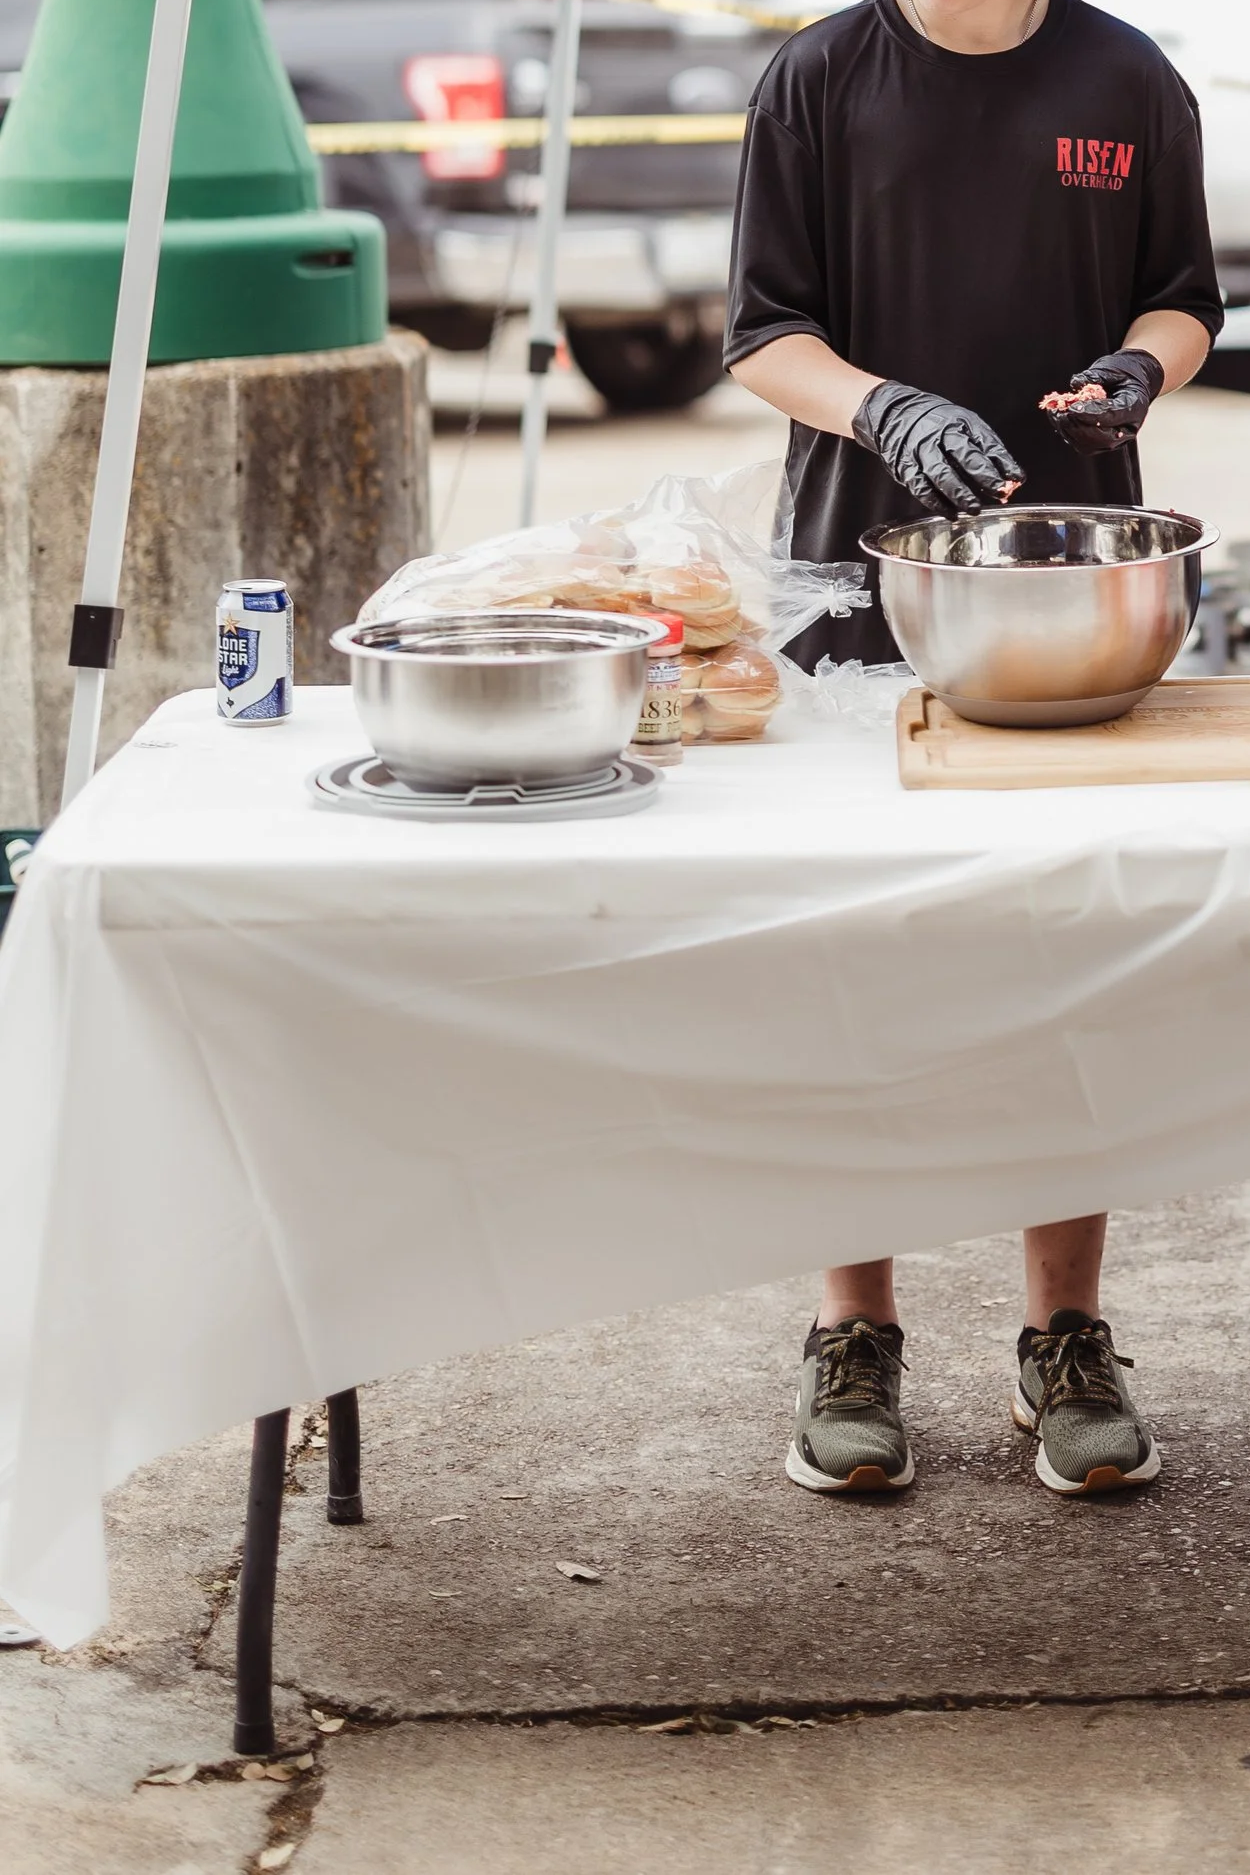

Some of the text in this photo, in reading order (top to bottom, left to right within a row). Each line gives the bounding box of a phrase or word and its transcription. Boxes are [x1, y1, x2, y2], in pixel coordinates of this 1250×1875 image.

[1057, 138, 1134, 177] RISEN
[1062, 173, 1123, 190] OVERHEAD
[218, 636, 247, 651] LONE
[218, 651, 248, 665] STAR
